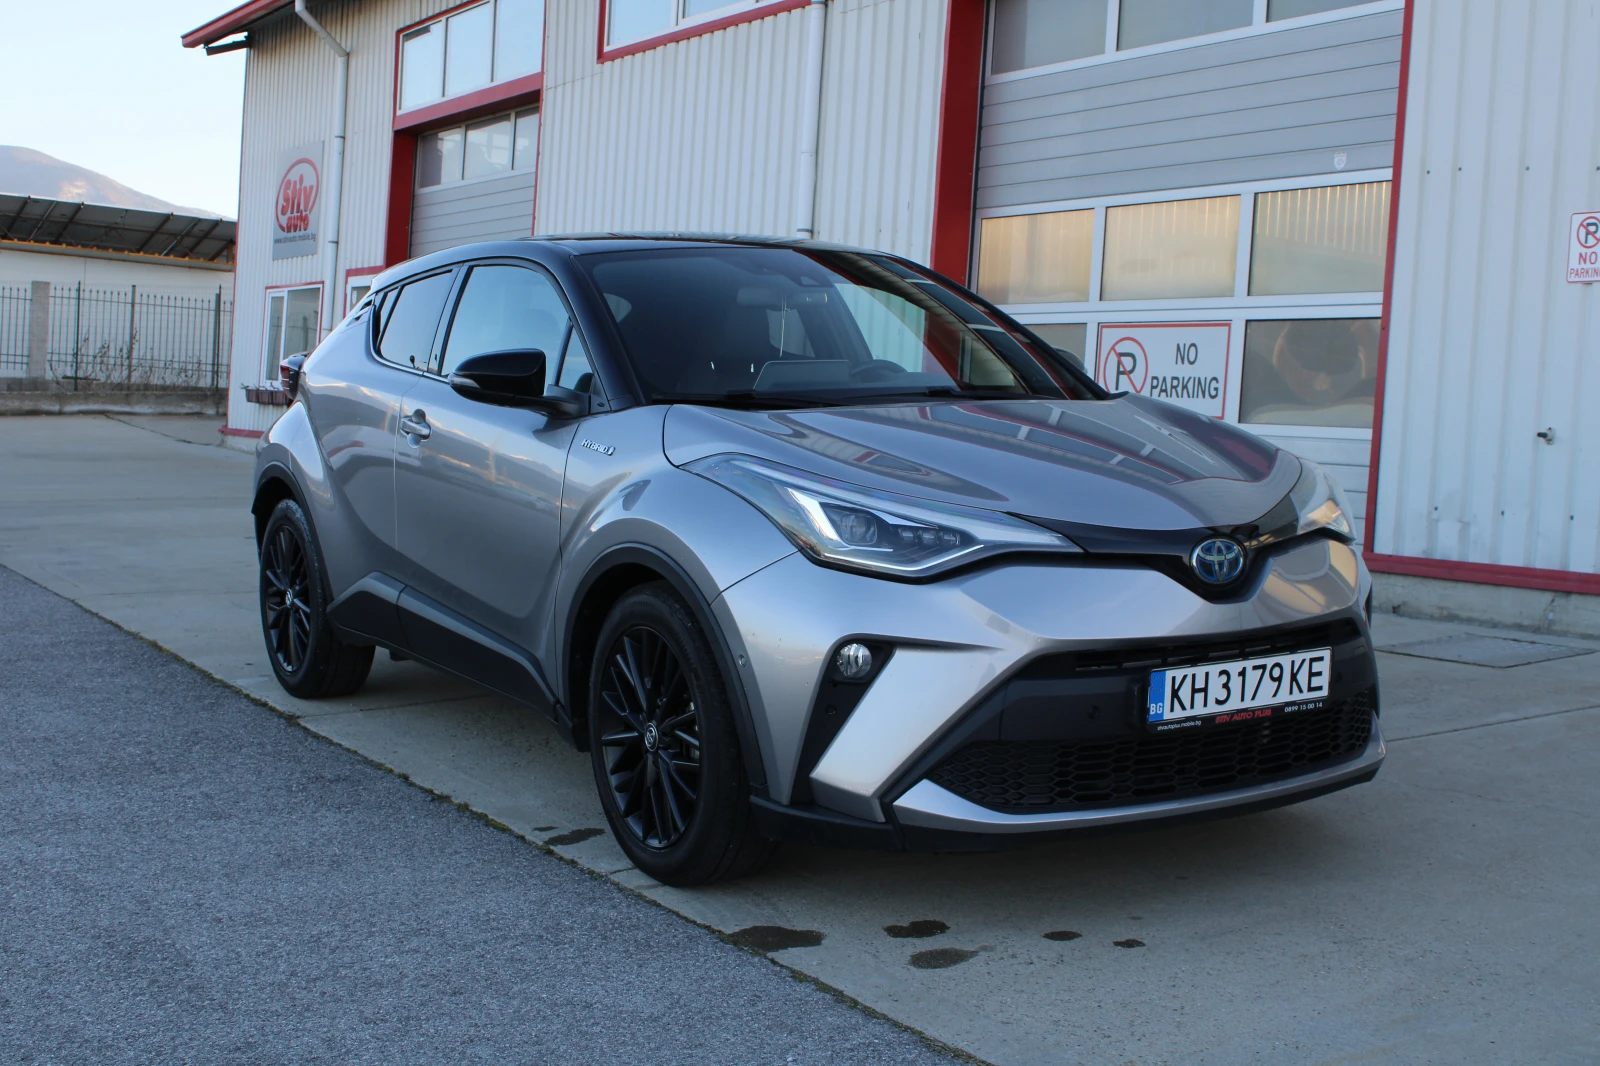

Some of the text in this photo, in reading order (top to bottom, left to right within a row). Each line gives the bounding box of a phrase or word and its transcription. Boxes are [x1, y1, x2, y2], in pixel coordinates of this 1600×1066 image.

[281, 173, 314, 216] Stiv
[286, 209, 309, 233] auto
[1578, 251, 1598, 265] NO
[1175, 342, 1199, 366] NO
[1150, 376, 1219, 399] PARKING
[581, 438, 608, 453] HYBRID
[1150, 702, 1164, 715] BG
[1232, 711, 1253, 722] AUTO
[1255, 709, 1272, 718] PLUS
